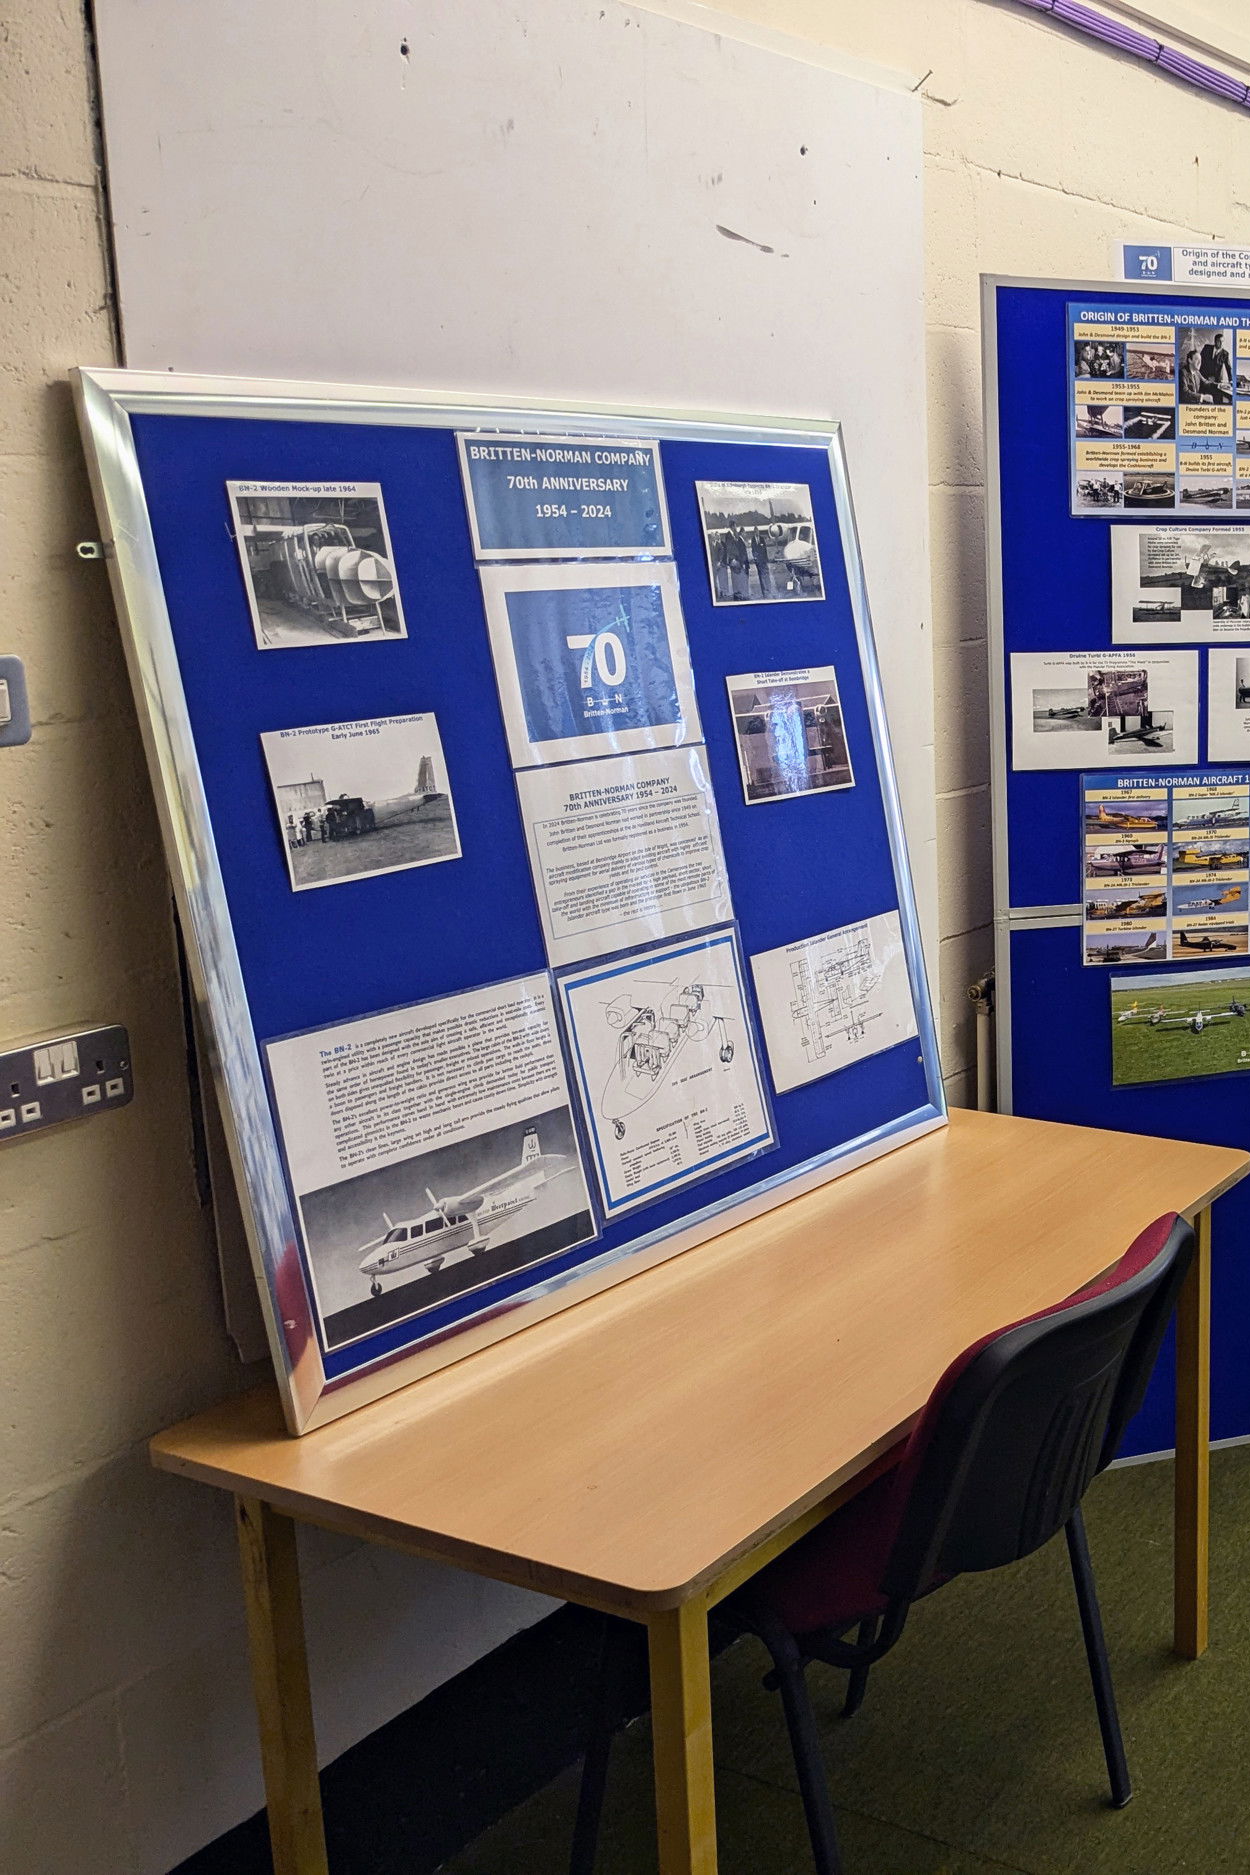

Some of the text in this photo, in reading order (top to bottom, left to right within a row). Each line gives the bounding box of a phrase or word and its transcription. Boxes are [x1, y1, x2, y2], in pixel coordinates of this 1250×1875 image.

[1181, 249, 1208, 259] Origin
[1210, 250, 1219, 258] of
[1221, 251, 1236, 259] the
[1139, 256, 1158, 270] 70
[1192, 259, 1208, 267] and
[1210, 259, 1243, 269] aircraft
[1188, 268, 1227, 278] designed
[1229, 270, 1246, 278] and
[1080, 311, 1115, 321] ORIGIN
[1117, 313, 1131, 322] OF
[1132, 313, 1217, 326] BRITTEN-NORMAN
[1219, 317, 1239, 326] AND
[470, 446, 650, 466] BRITTEN-NORMAN COMPANY
[507, 476, 629, 491] 70th ANNIVERSARY
[536, 505, 612, 518] 1954 2024
[566, 632, 627, 689] 70
[583, 707, 629, 718] Britten-Norman
[280, 730, 297, 738] BN-2
[298, 726, 329, 737] Prototype
[330, 723, 354, 732] G-ATCT
[370, 719, 388, 728] Flight
[388, 715, 423, 725] Preparation
[348, 730, 363, 738] June
[364, 728, 380, 736] 1965
[1117, 777, 1200, 788] BRITTEN-NORMAN
[1202, 775, 1243, 785] AIRCRAFT
[569, 777, 670, 802] BRITTEN-NORMAN COMPANY
[564, 785, 678, 812] 70th ANNIVERSARY 1954 2024
[560, 815, 594, 826] Britten-Norman
[320, 1050, 332, 1058] The
[334, 1044, 352, 1054] BN-2
